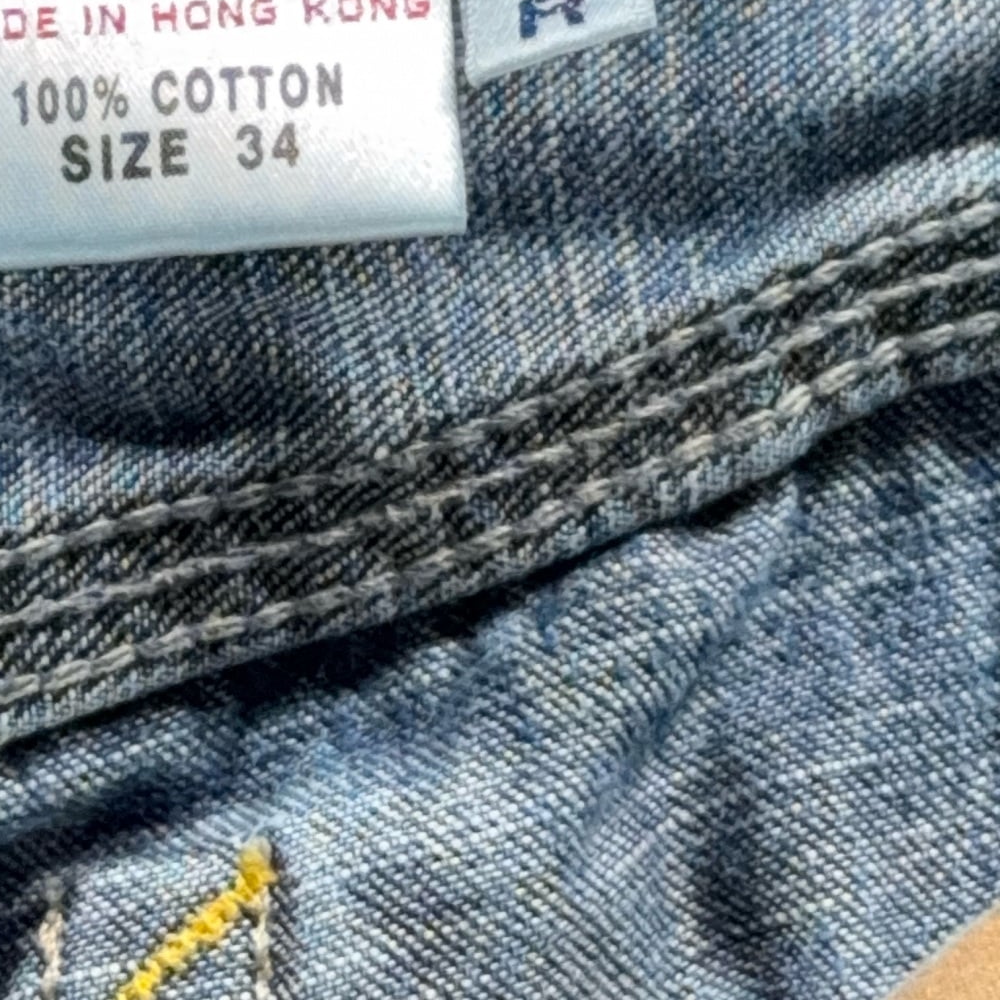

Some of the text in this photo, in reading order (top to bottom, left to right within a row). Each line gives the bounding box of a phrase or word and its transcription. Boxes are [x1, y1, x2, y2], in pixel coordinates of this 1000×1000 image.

[83, 3, 127, 35] IN
[12, 62, 345, 127] 100% COTTON
[60, 121, 301, 185] SIZE 34
